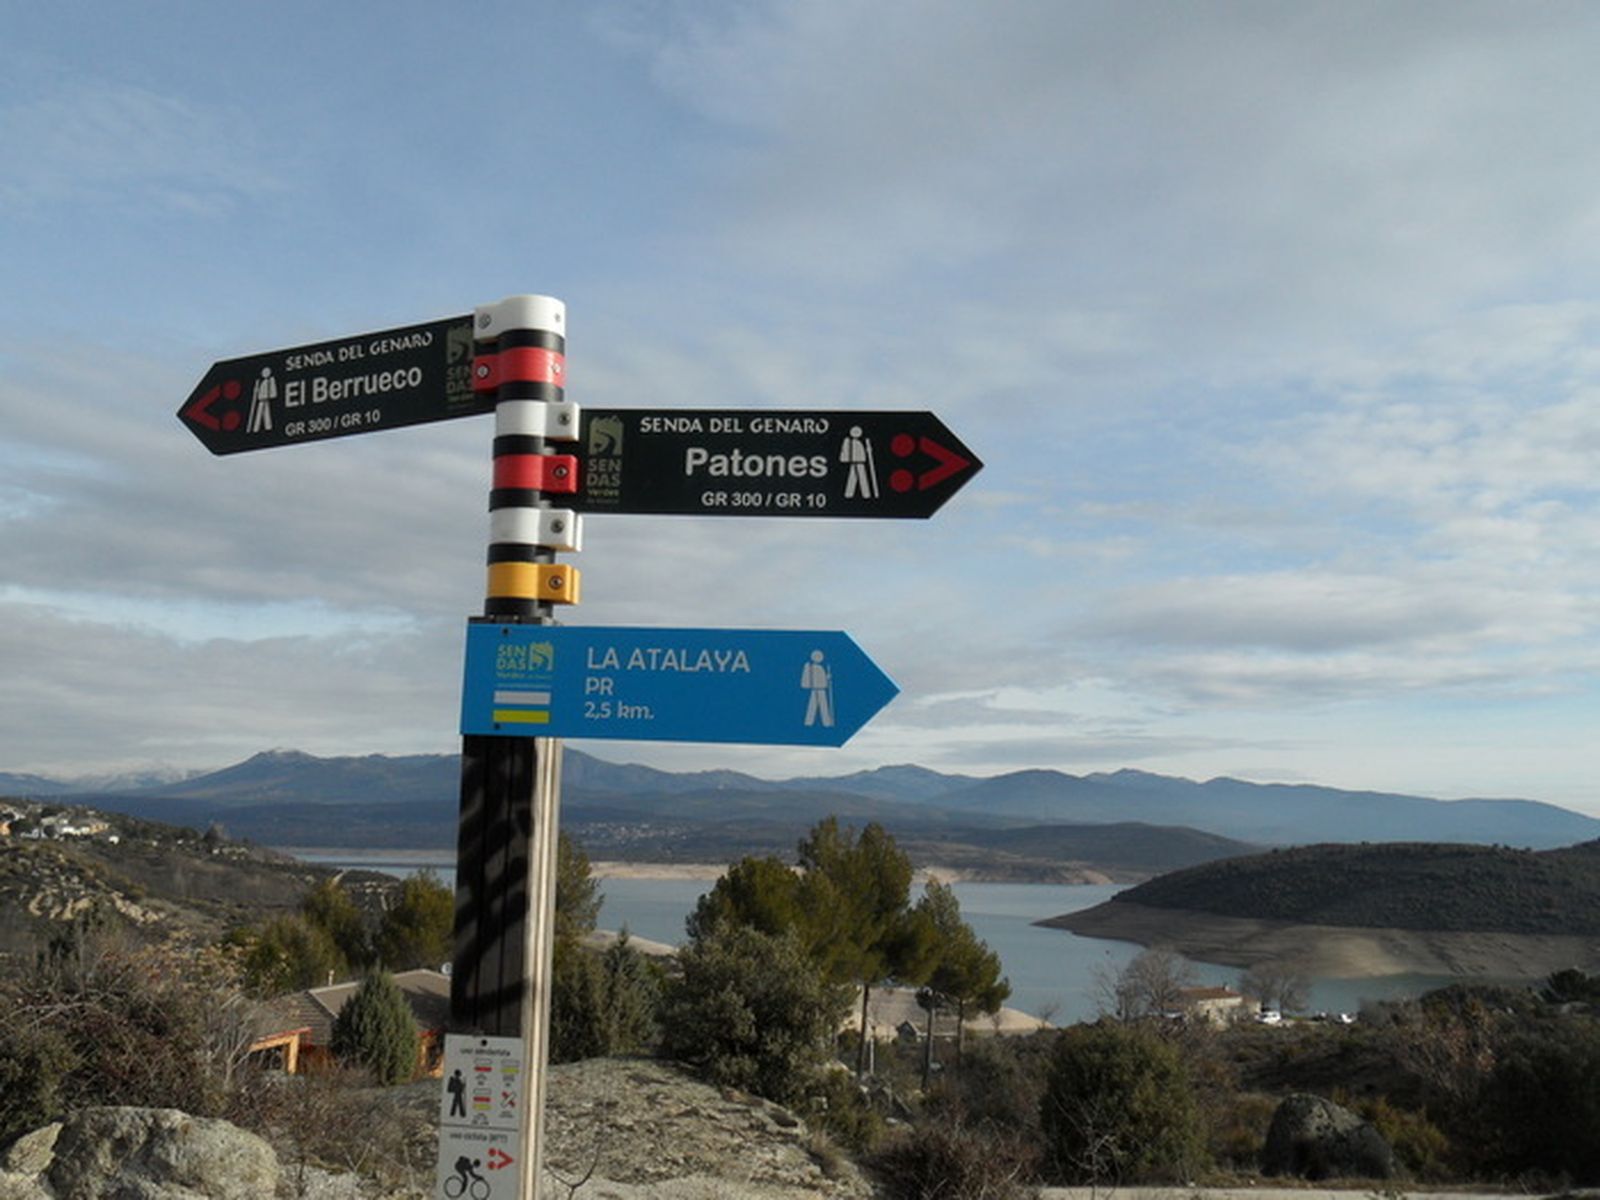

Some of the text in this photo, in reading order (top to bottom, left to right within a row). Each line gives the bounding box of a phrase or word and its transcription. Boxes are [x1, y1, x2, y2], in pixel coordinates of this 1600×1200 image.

[285, 331, 433, 371] SENDA DEL GENARO
[285, 366, 422, 408] El Berrueco
[285, 420, 305, 437] GR
[308, 417, 332, 433] 300
[341, 412, 361, 428] GR
[365, 409, 381, 424] 10
[640, 416, 829, 434] SENDA DEL GENARO
[588, 458, 622, 472] SEN
[685, 447, 828, 477] Patones
[587, 473, 621, 488] DAS
[701, 491, 827, 508] GR 300 / GR 10
[586, 647, 751, 673] LA ATALAYA
[585, 677, 614, 696] PR
[584, 701, 655, 721] 2,5 km.
